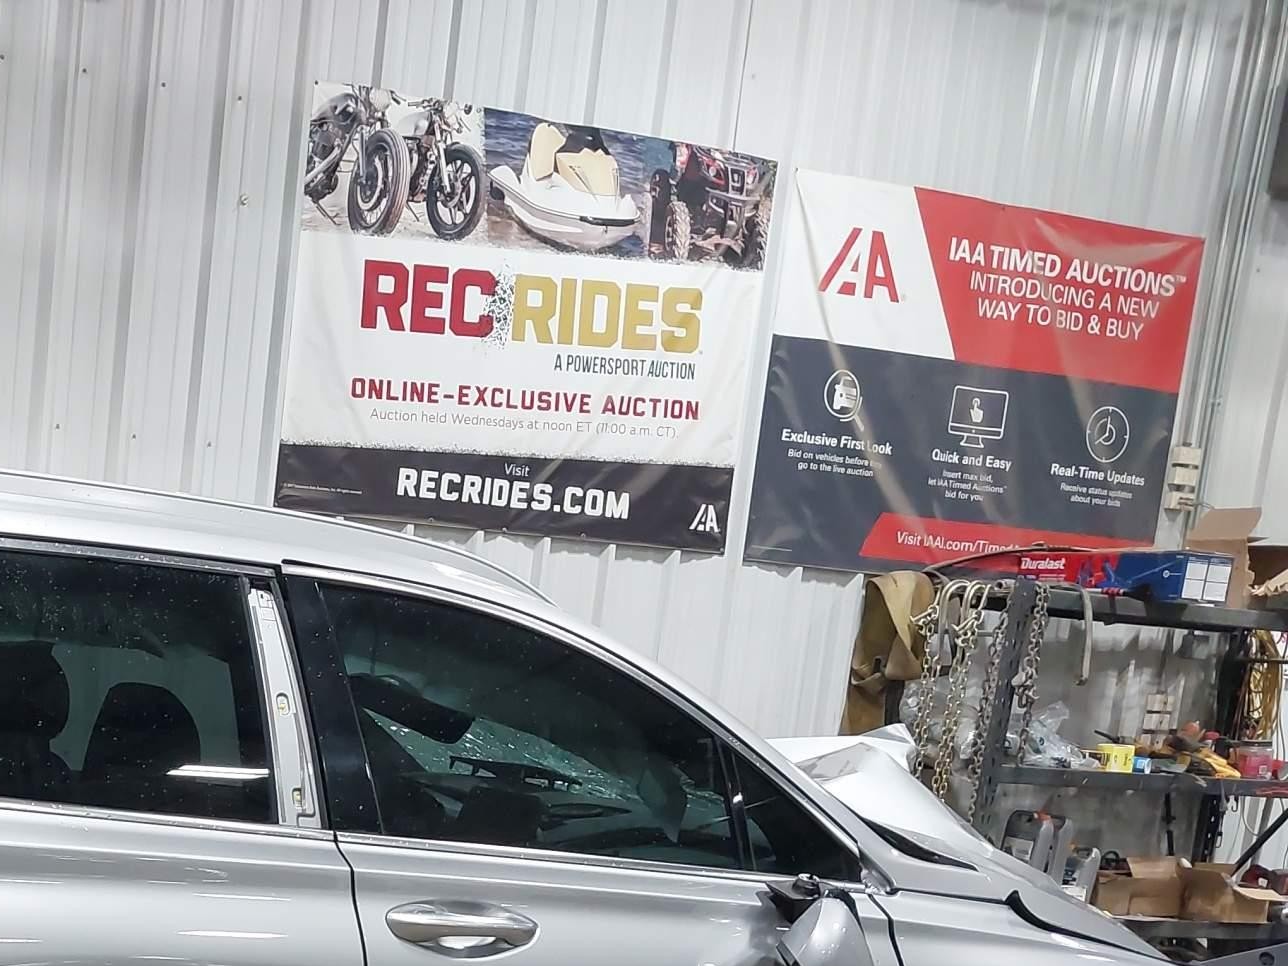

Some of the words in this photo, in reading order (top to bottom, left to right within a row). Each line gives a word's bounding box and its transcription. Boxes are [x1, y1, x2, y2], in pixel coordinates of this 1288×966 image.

[948, 237, 985, 267] IAA
[989, 245, 1062, 278] TIMED
[969, 270, 1095, 310] INTRODUCING
[1099, 292, 1113, 312] A
[1116, 294, 1160, 319] NEW
[360, 259, 498, 338] REC
[510, 273, 703, 354] RIDES
[977, 297, 1022, 321] WAY
[1025, 303, 1051, 326] TO
[1056, 309, 1083, 331] BID
[1087, 314, 1101, 335] &
[1106, 317, 1145, 341] BUY
[553, 353, 563, 371] A
[566, 354, 647, 377] POWERSPORT
[647, 359, 696, 380] AUCTION
[351, 377, 592, 415] ONLINE-EXCLUSIVE
[600, 394, 700, 421] AUCTION
[369, 407, 418, 422] Auction
[421, 410, 447, 424] held
[451, 413, 525, 431] Wednesdays
[526, 420, 539, 430] at
[543, 421, 573, 432] noon
[576, 421, 593, 433] ET
[781, 428, 838, 448] Exclusive
[839, 435, 866, 451] First
[787, 448, 802, 459] Bid
[803, 451, 814, 460] on
[815, 453, 845, 464] vehicles
[844, 455, 869, 467] before
[931, 448, 960, 465] Quick
[961, 455, 983, 467] and
[985, 455, 1012, 472] Easy
[504, 462, 530, 477] Visit
[797, 461, 808, 471] go
[809, 462, 818, 471] to
[819, 463, 832, 472] the
[832, 464, 846, 474] live
[846, 467, 874, 478] auction
[962, 472, 978, 481] max
[1050, 463, 1105, 481] Real-Time
[1106, 469, 1145, 486] Updates
[396, 467, 630, 520] RECRIDES.COM
[944, 489, 957, 499] bid
[958, 490, 970, 500] for
[969, 494, 985, 502] you
[948, 479, 972, 491] Timed
[1070, 494, 1091, 504] about
[896, 531, 921, 546] Visit
[1020, 557, 1066, 570] Duralast
